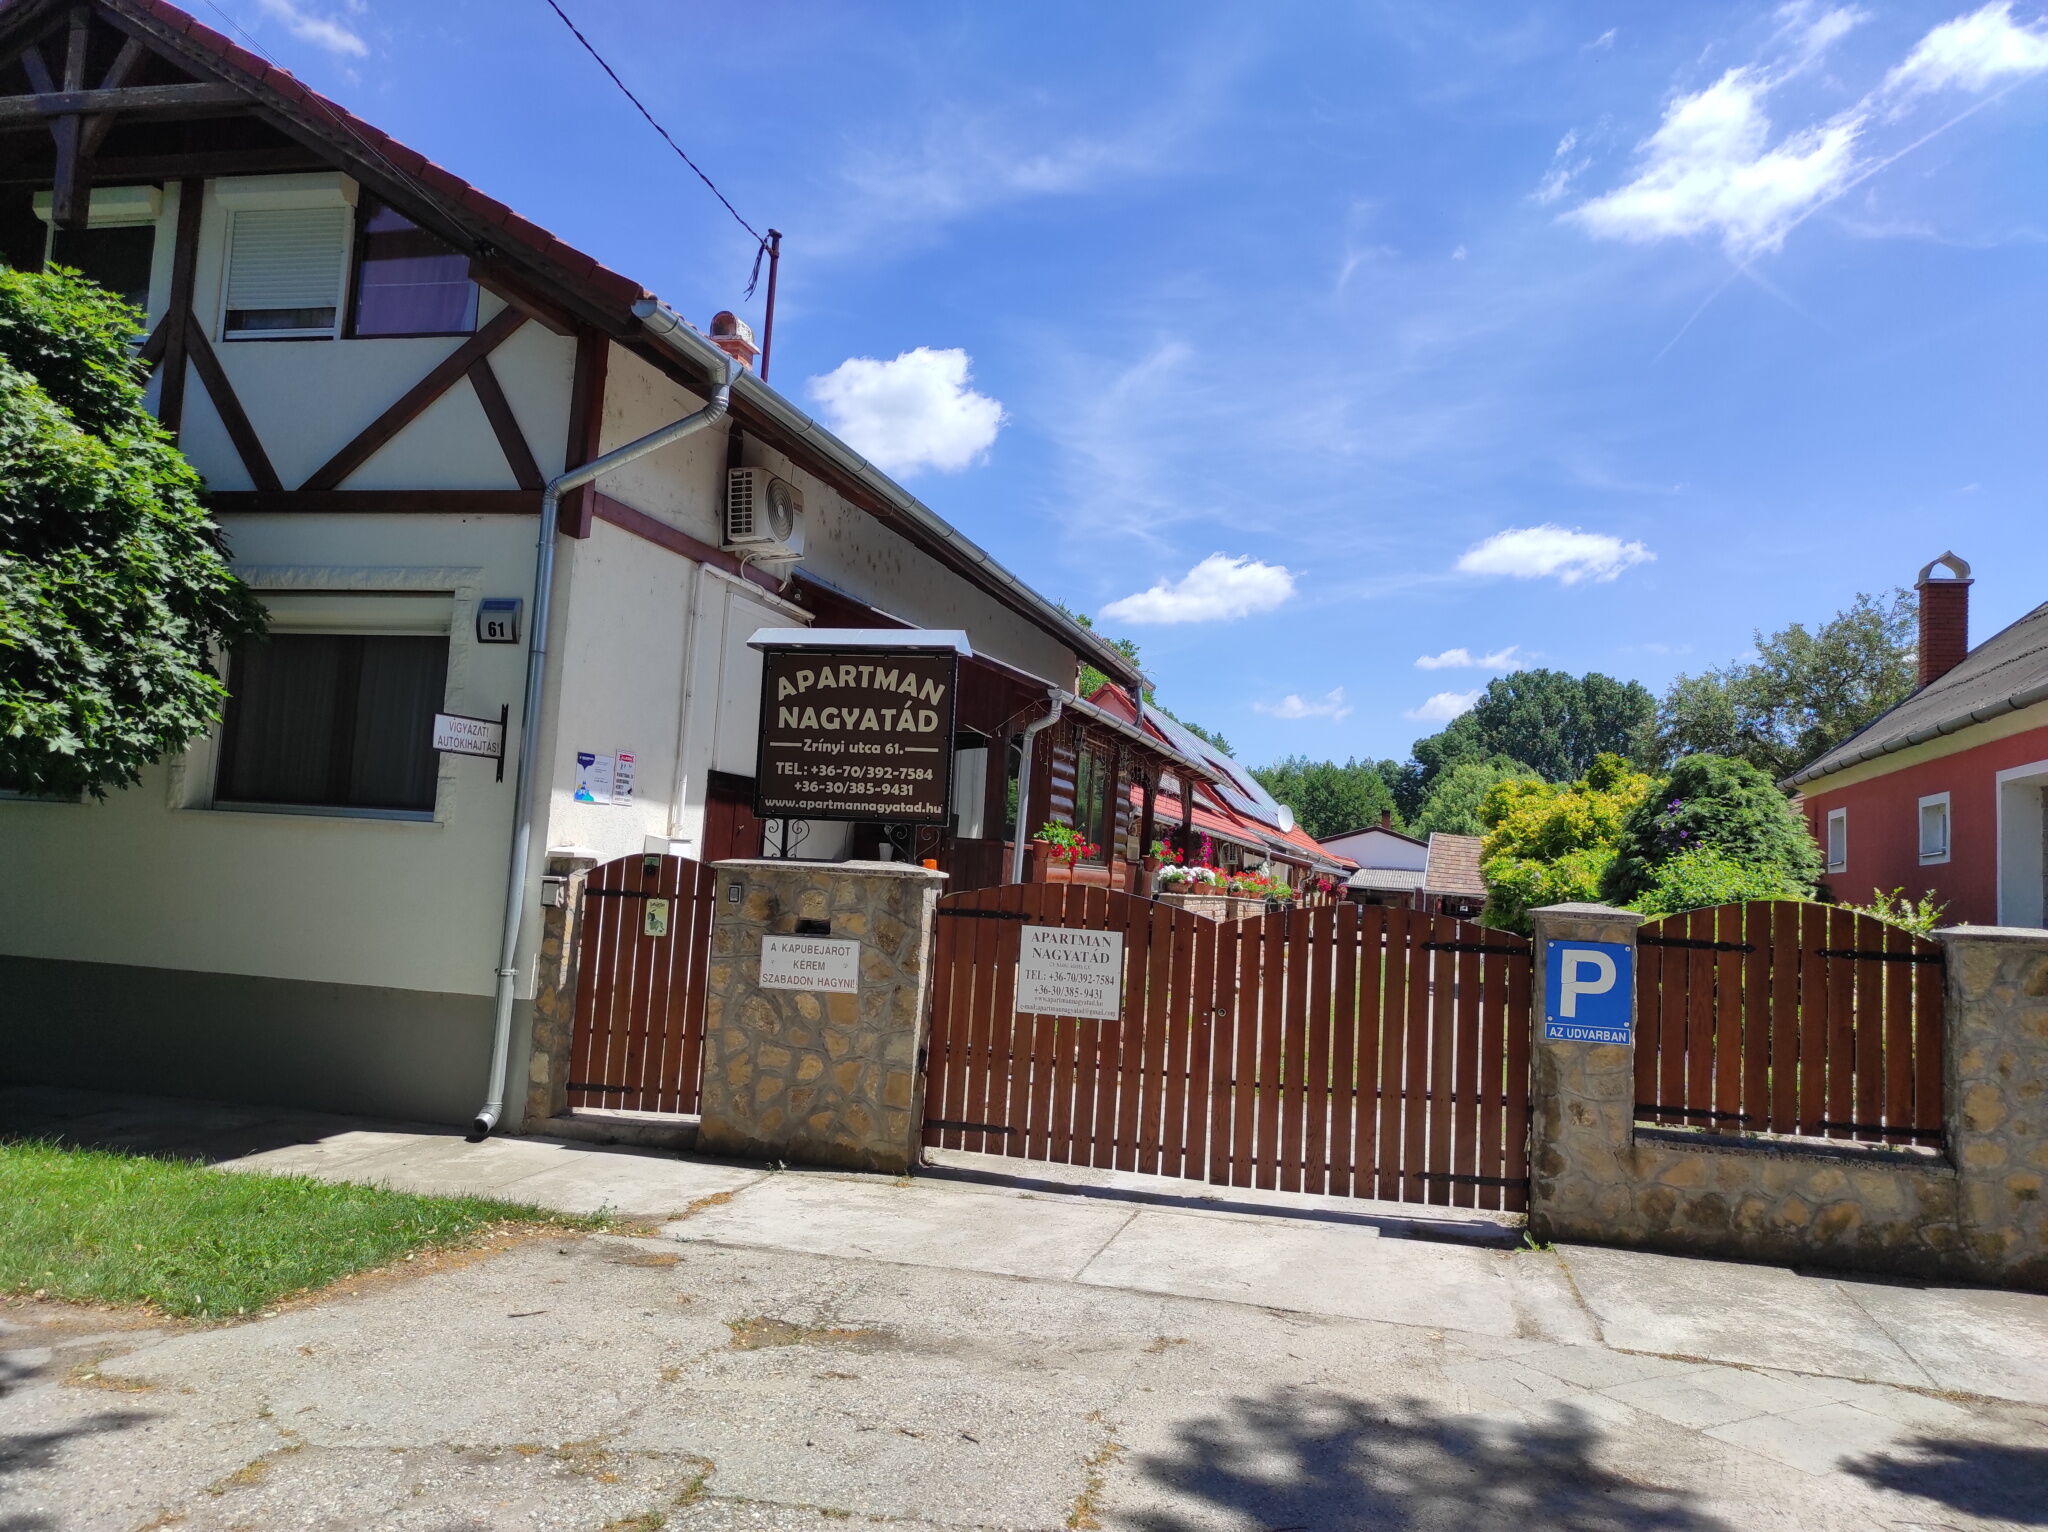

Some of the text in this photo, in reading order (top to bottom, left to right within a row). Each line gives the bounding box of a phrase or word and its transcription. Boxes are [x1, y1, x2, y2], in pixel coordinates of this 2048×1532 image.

[487, 621, 505, 638] 61
[778, 664, 946, 706] APARTMAN
[777, 700, 939, 733] NAGYATÁD
[803, 738, 904, 755] Zrínyi utca 61.
[776, 762, 934, 781] TEL: +36-70/392-7584
[794, 781, 914, 796] +36-30/385-9431
[765, 798, 942, 814] www.apartmannagyatad.hu
[1031, 931, 1112, 948] APARTMAN
[770, 942, 851, 956] A KAPUBEJÁRÓT
[1032, 947, 1110, 964] NAGYATÁD
[793, 958, 826, 970] KÉREM
[762, 973, 855, 987] SZABADON HAGYNI!
[1025, 969, 1115, 986] TEL: +36-70/392-7584
[1560, 949, 1617, 1017] P
[1034, 984, 1103, 1000] +36-30/385-9431
[1549, 1027, 1627, 1042] AZ UDVARBAN
